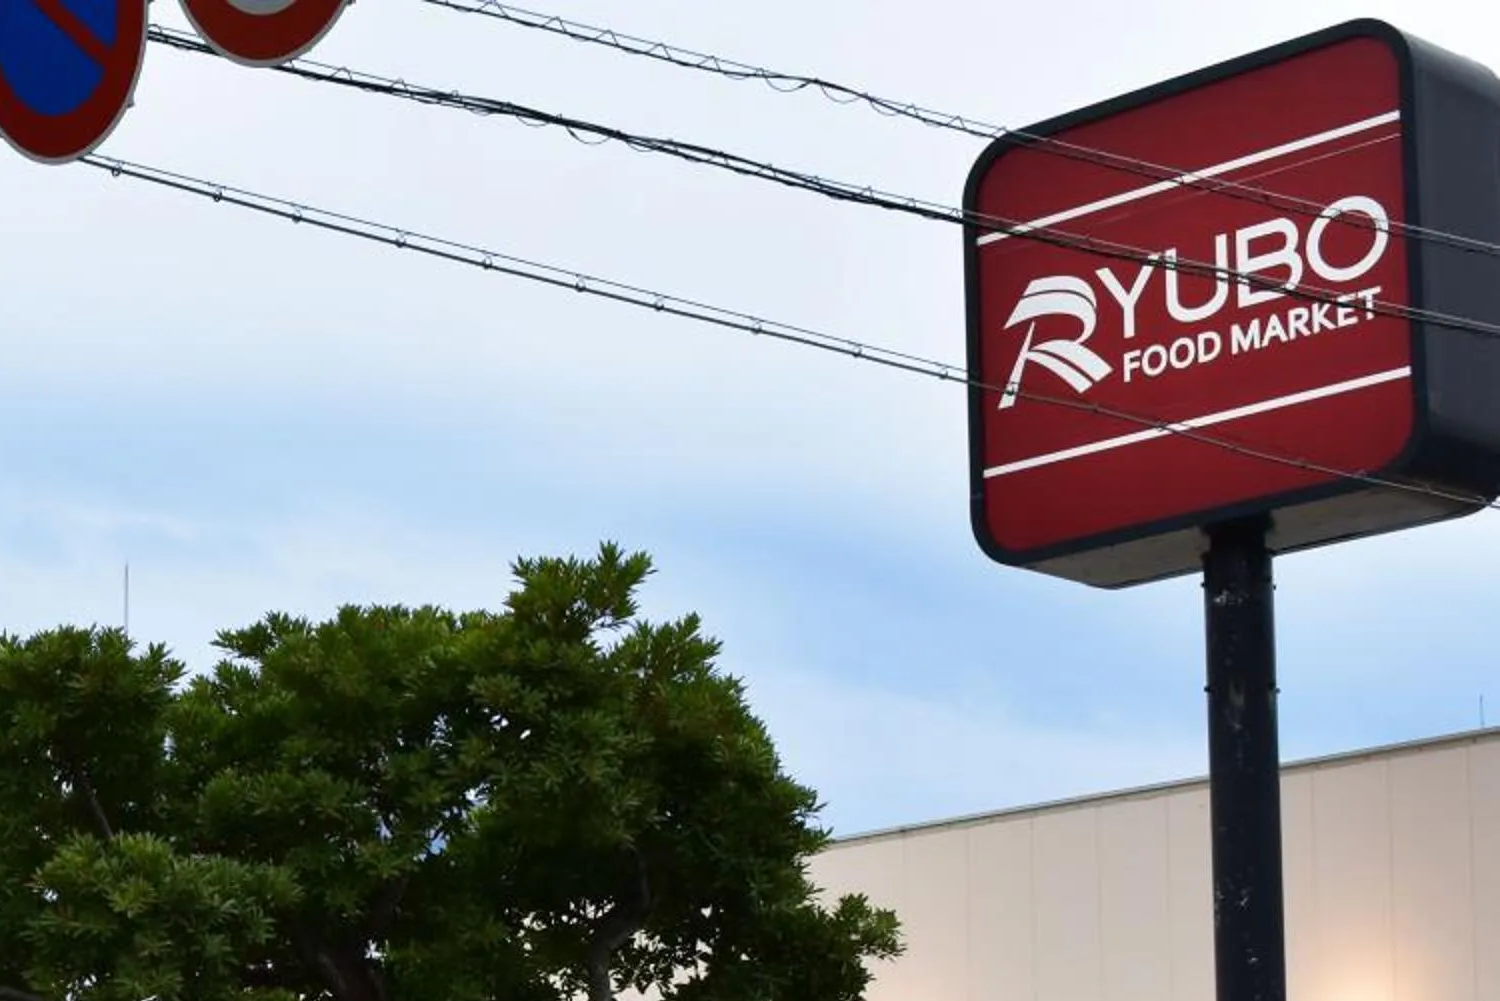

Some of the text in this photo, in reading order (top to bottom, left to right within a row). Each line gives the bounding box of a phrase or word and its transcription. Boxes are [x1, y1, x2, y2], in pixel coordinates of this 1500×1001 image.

[998, 195, 1390, 410] RYUBO
[1122, 286, 1382, 383] FOOD MARKET
